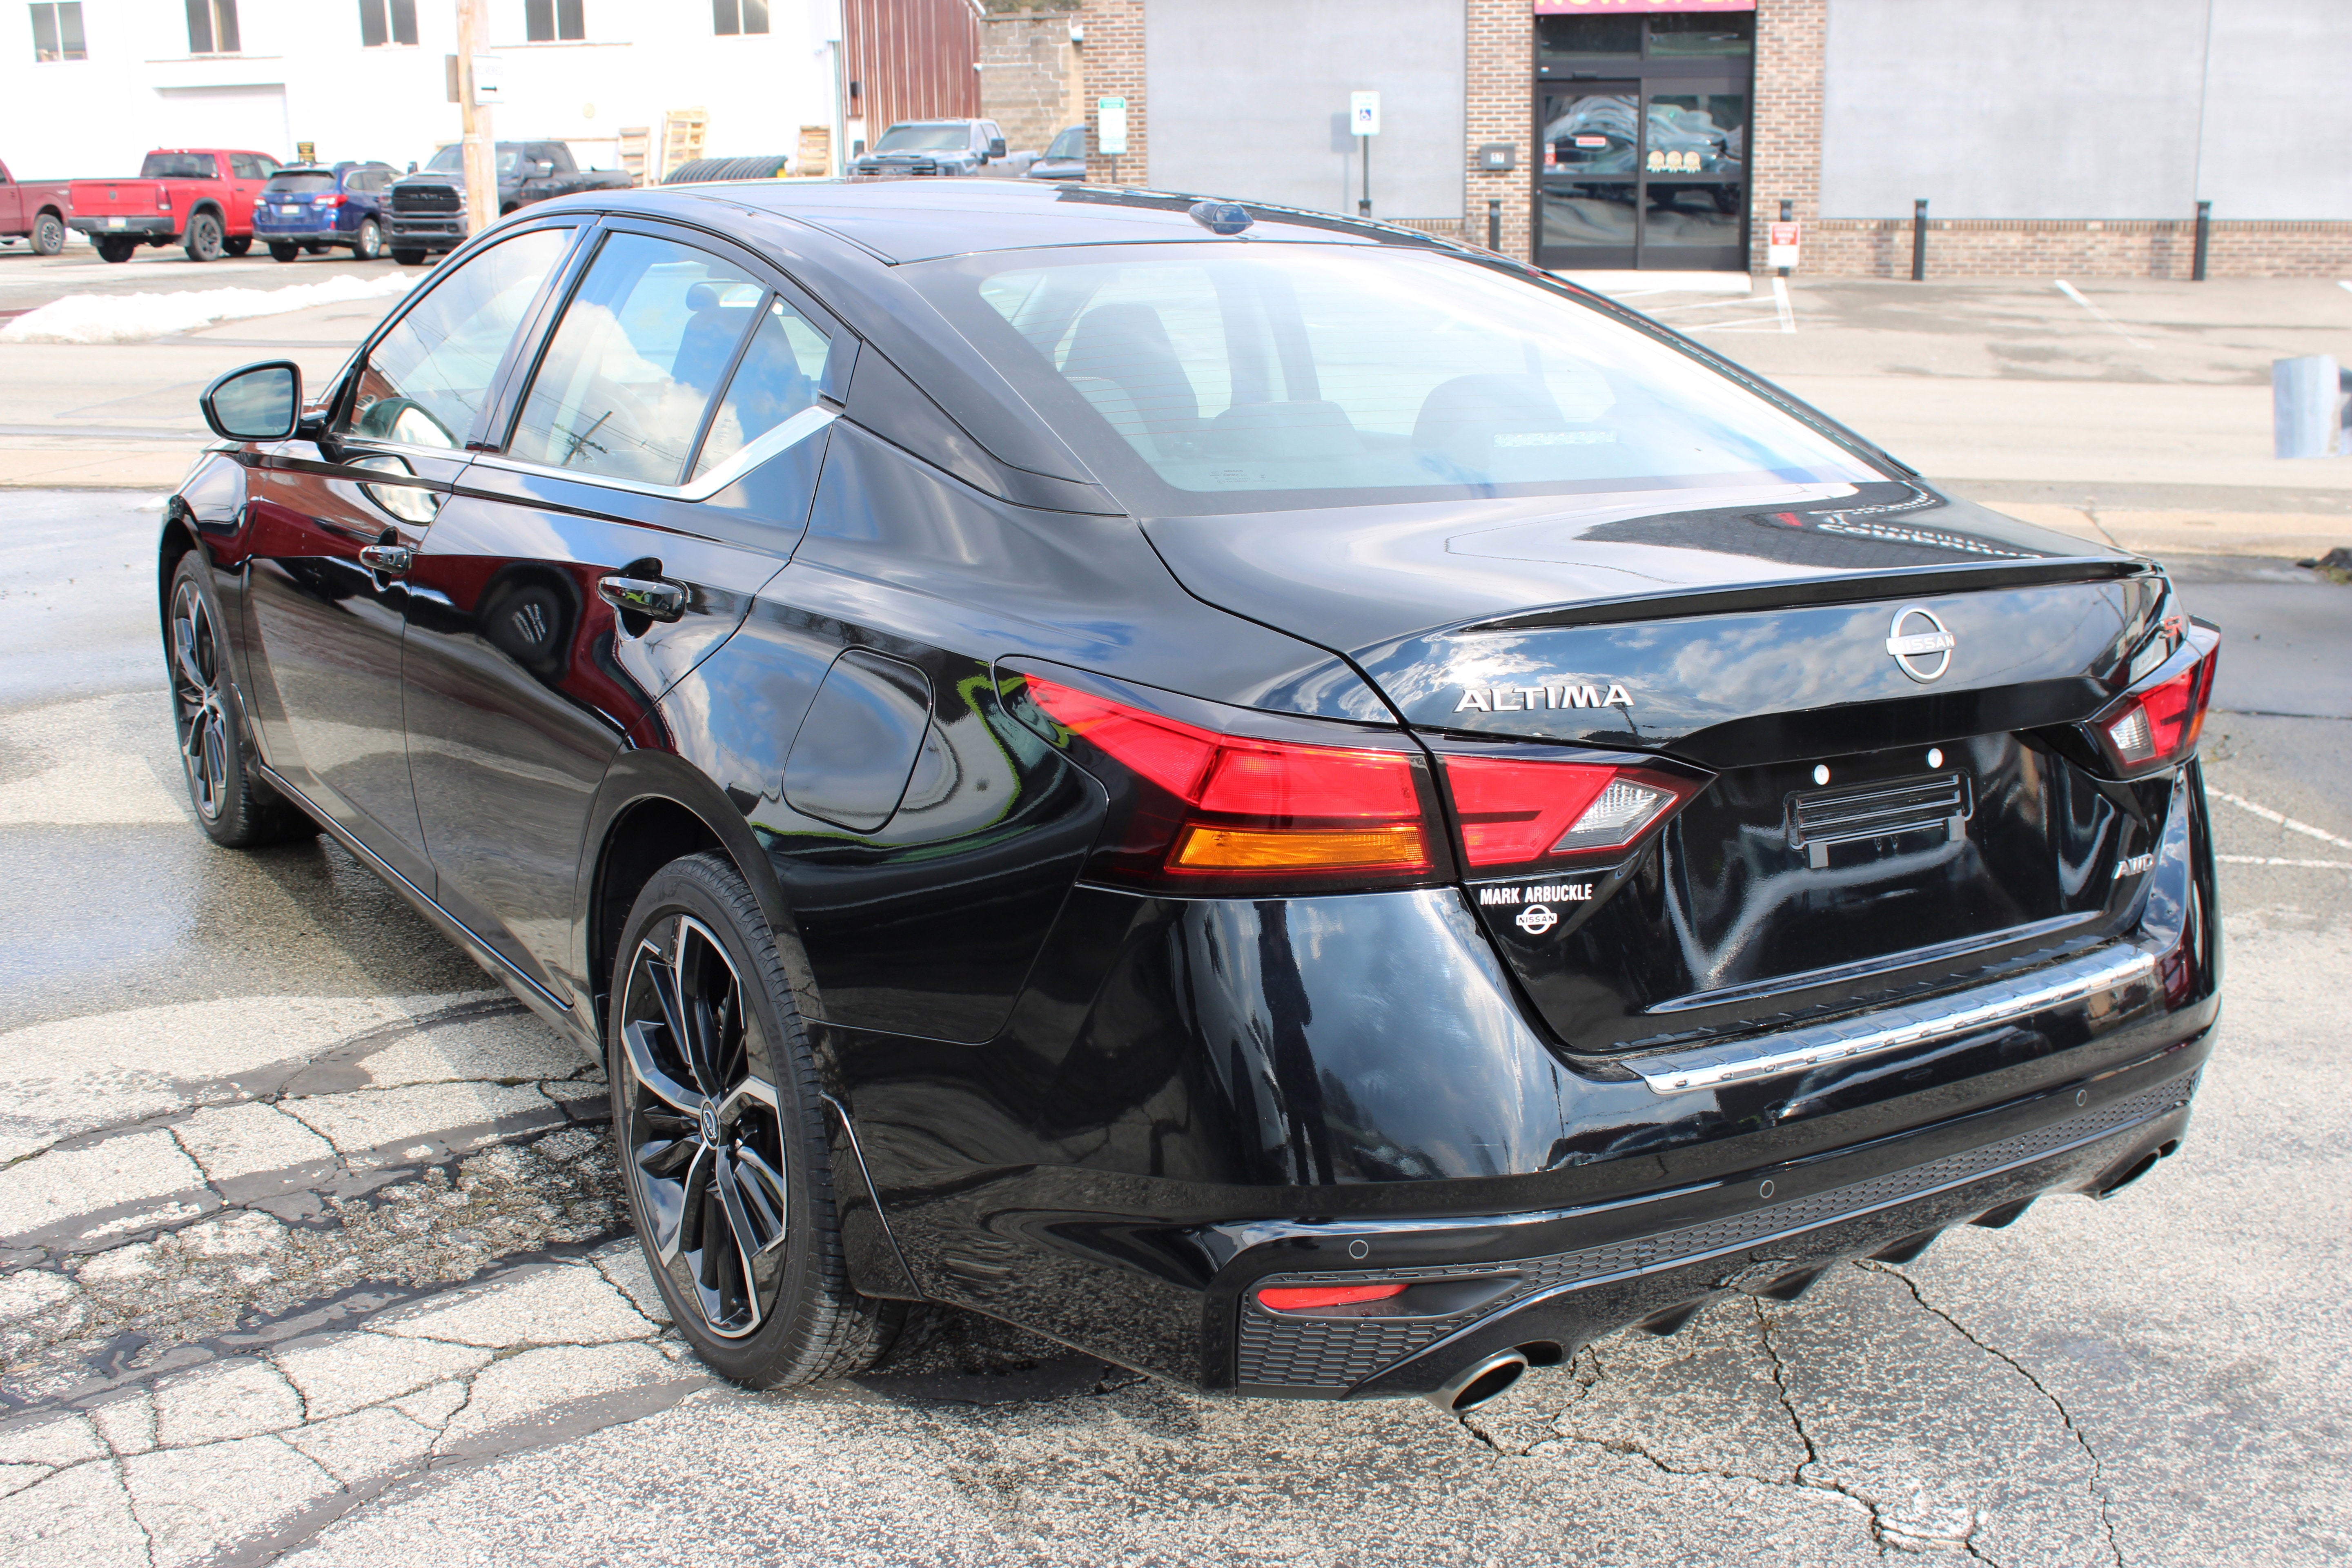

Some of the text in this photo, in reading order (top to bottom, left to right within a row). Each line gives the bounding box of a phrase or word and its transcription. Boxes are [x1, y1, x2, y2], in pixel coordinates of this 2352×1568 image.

[2161, 615, 2183, 638] SR
[1452, 685, 1634, 713] ALTIMA
[2113, 853, 2155, 880] AWD
[1480, 883, 1592, 905] MARK ARBUCKLE
[1519, 915, 1555, 923] NISSAN
